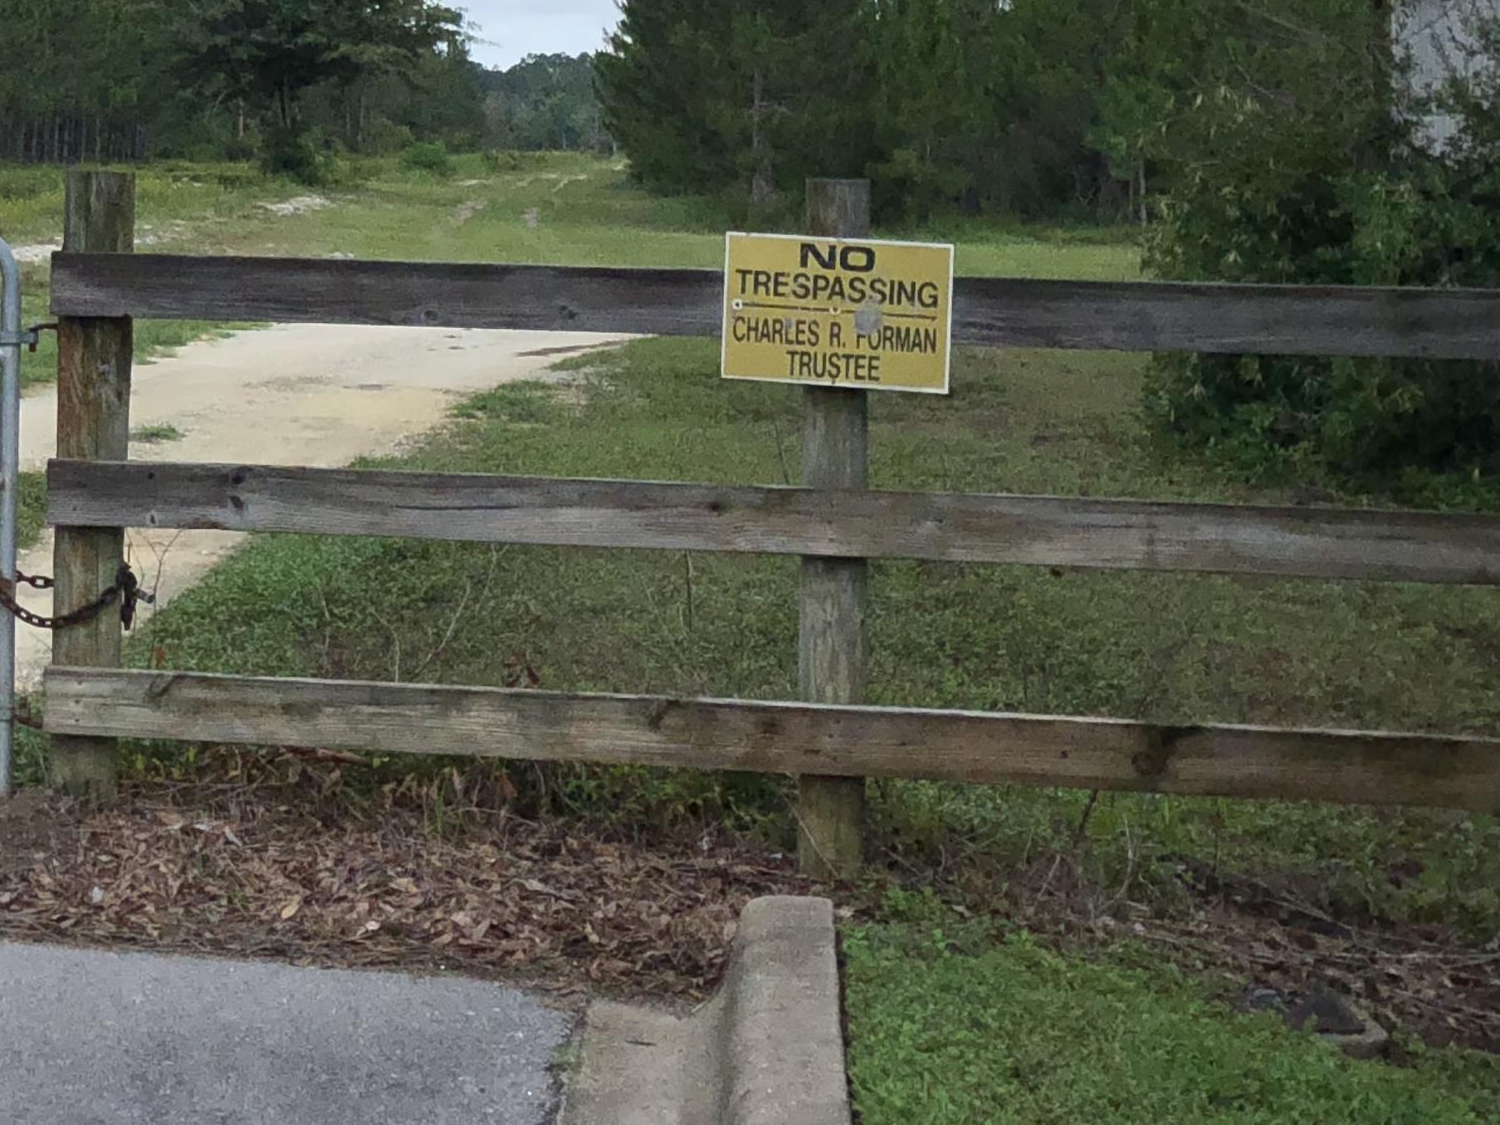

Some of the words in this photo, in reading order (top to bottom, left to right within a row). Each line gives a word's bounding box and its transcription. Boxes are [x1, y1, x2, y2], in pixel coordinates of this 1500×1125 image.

[799, 243, 876, 272] NO
[735, 269, 938, 308] TRESPASSING
[733, 316, 820, 347] CHARLES
[829, 321, 846, 348] R.
[786, 350, 881, 382] TRUSTEE
